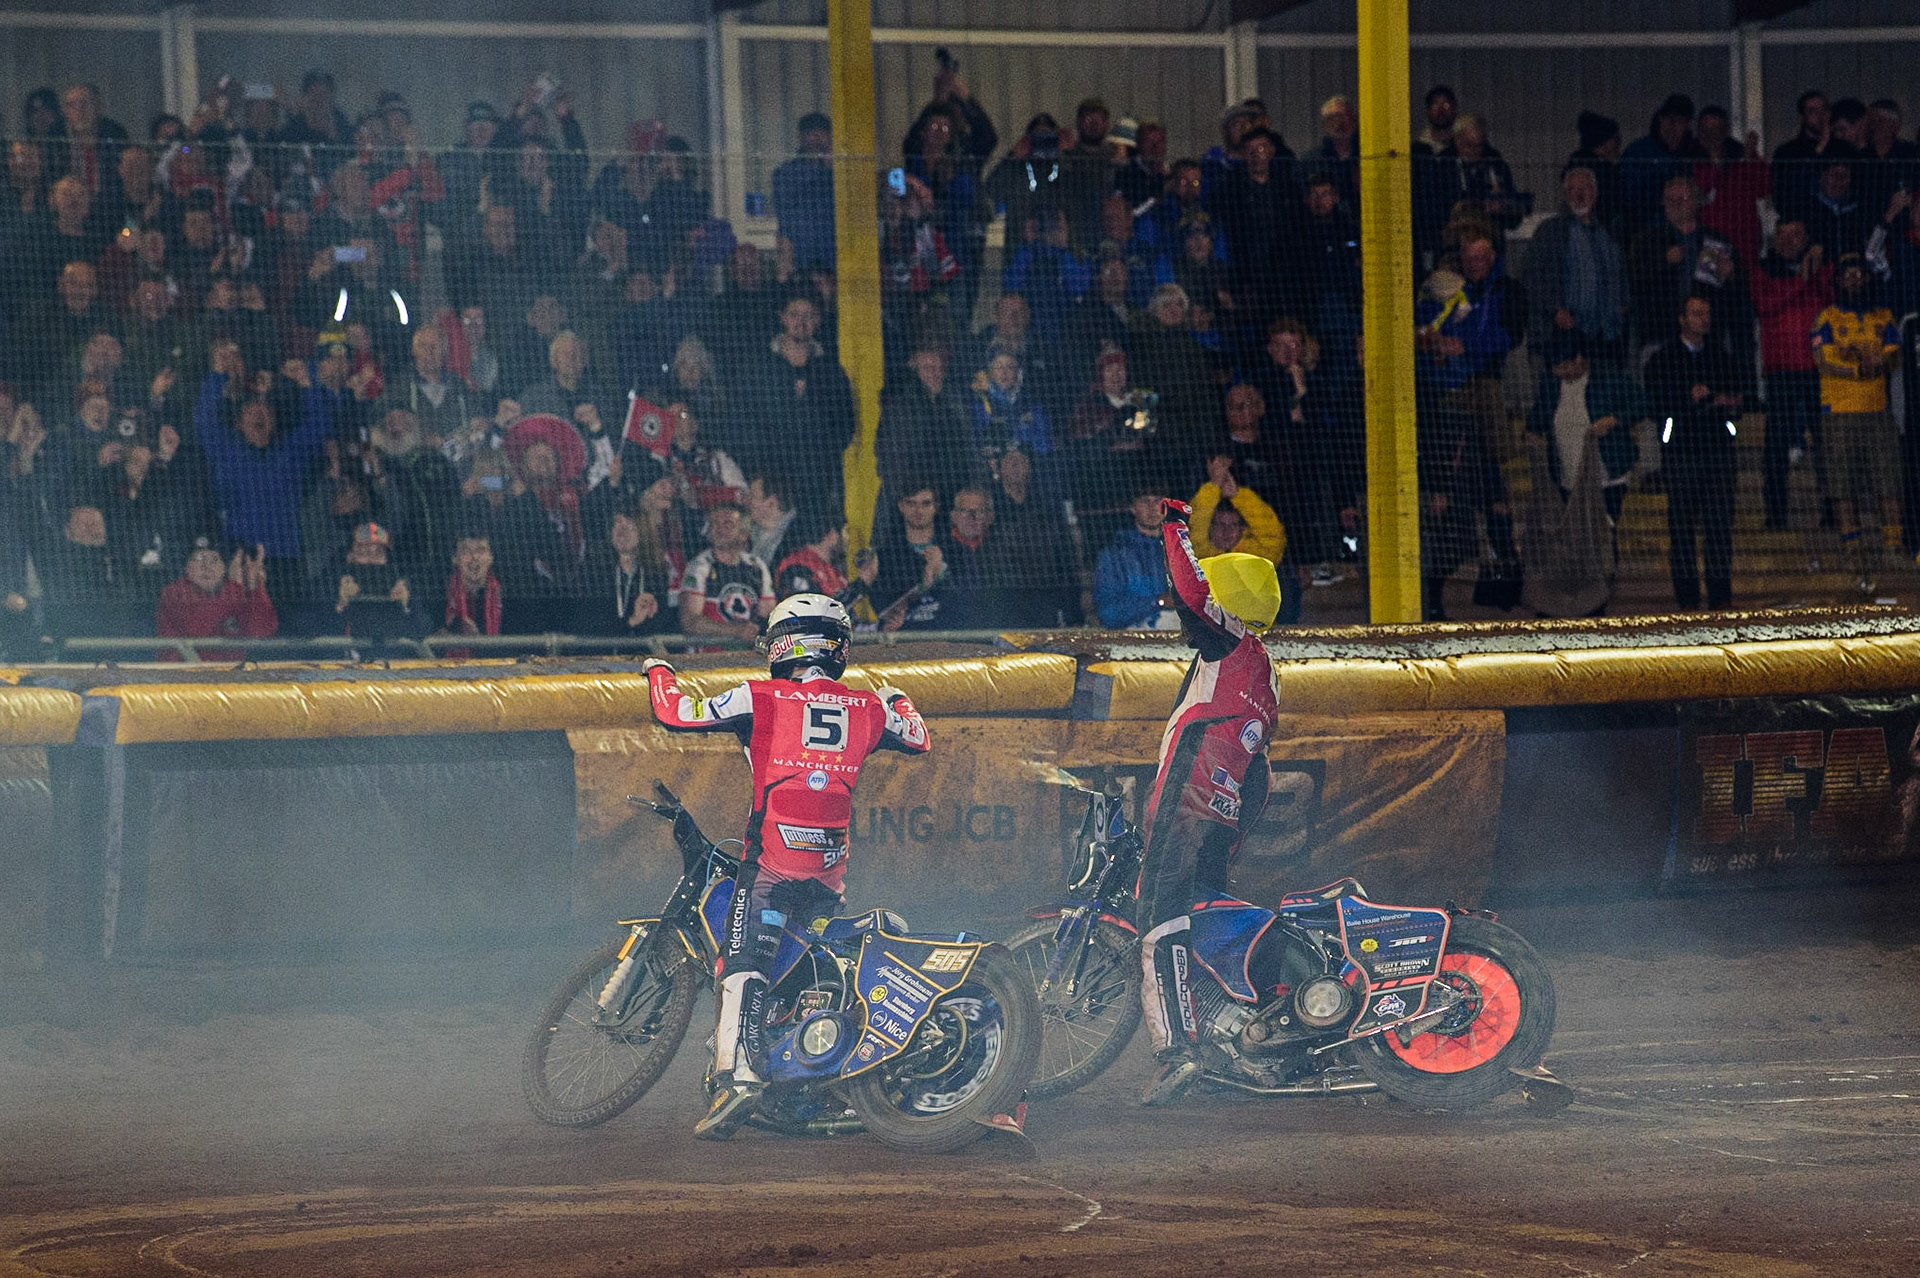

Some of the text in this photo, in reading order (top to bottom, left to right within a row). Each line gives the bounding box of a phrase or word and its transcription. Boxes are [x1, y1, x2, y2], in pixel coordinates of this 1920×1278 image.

[774, 690, 868, 707] LAMBERT
[809, 708, 842, 745] 5
[773, 758, 859, 773] MANCHESTER
[948, 803, 1017, 843] JCB
[729, 888, 747, 957] Teletecnica
[1362, 917, 1380, 925] House
[1381, 913, 1411, 922] Warehouse
[891, 967, 905, 979] Jörg
[904, 975, 933, 997] Grohmann
[883, 1019, 908, 1040] Nice
